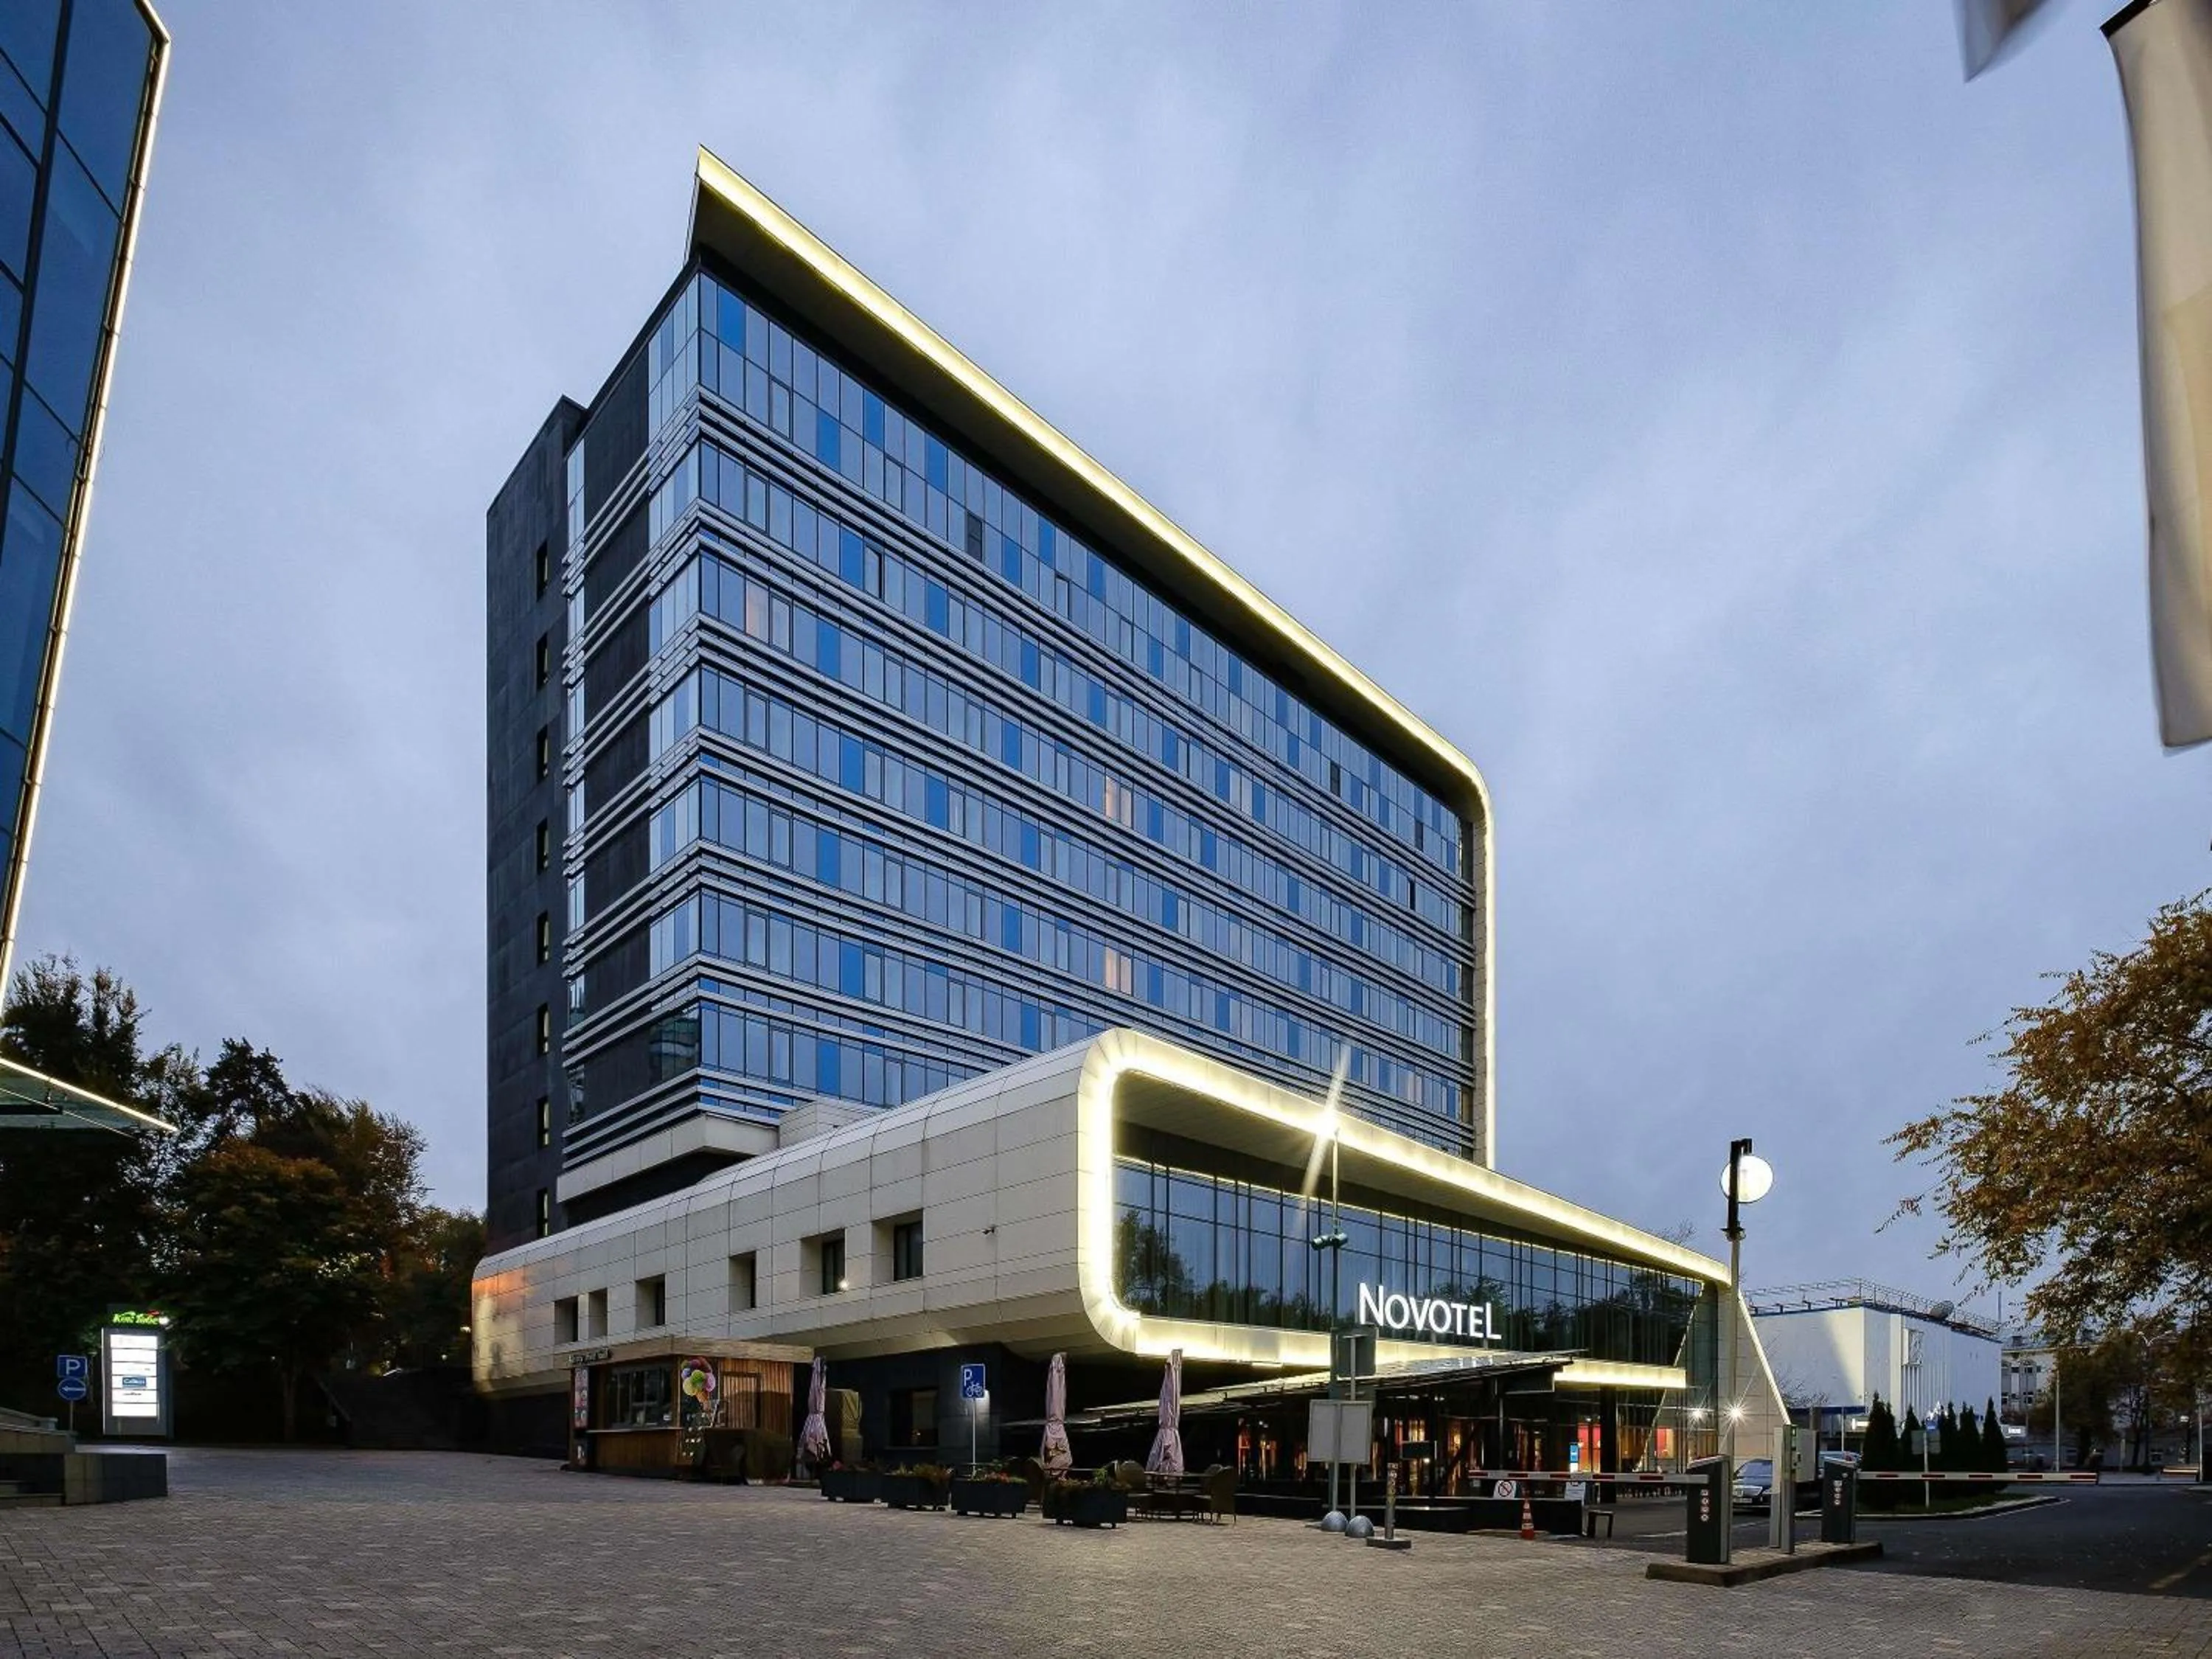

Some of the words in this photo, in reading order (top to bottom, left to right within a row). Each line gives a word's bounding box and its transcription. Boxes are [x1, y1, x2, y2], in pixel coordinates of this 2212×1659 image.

[1359, 1282, 1502, 1340] NOVOTEL
[66, 1359, 80, 1375] P
[964, 1368, 973, 1387] P
